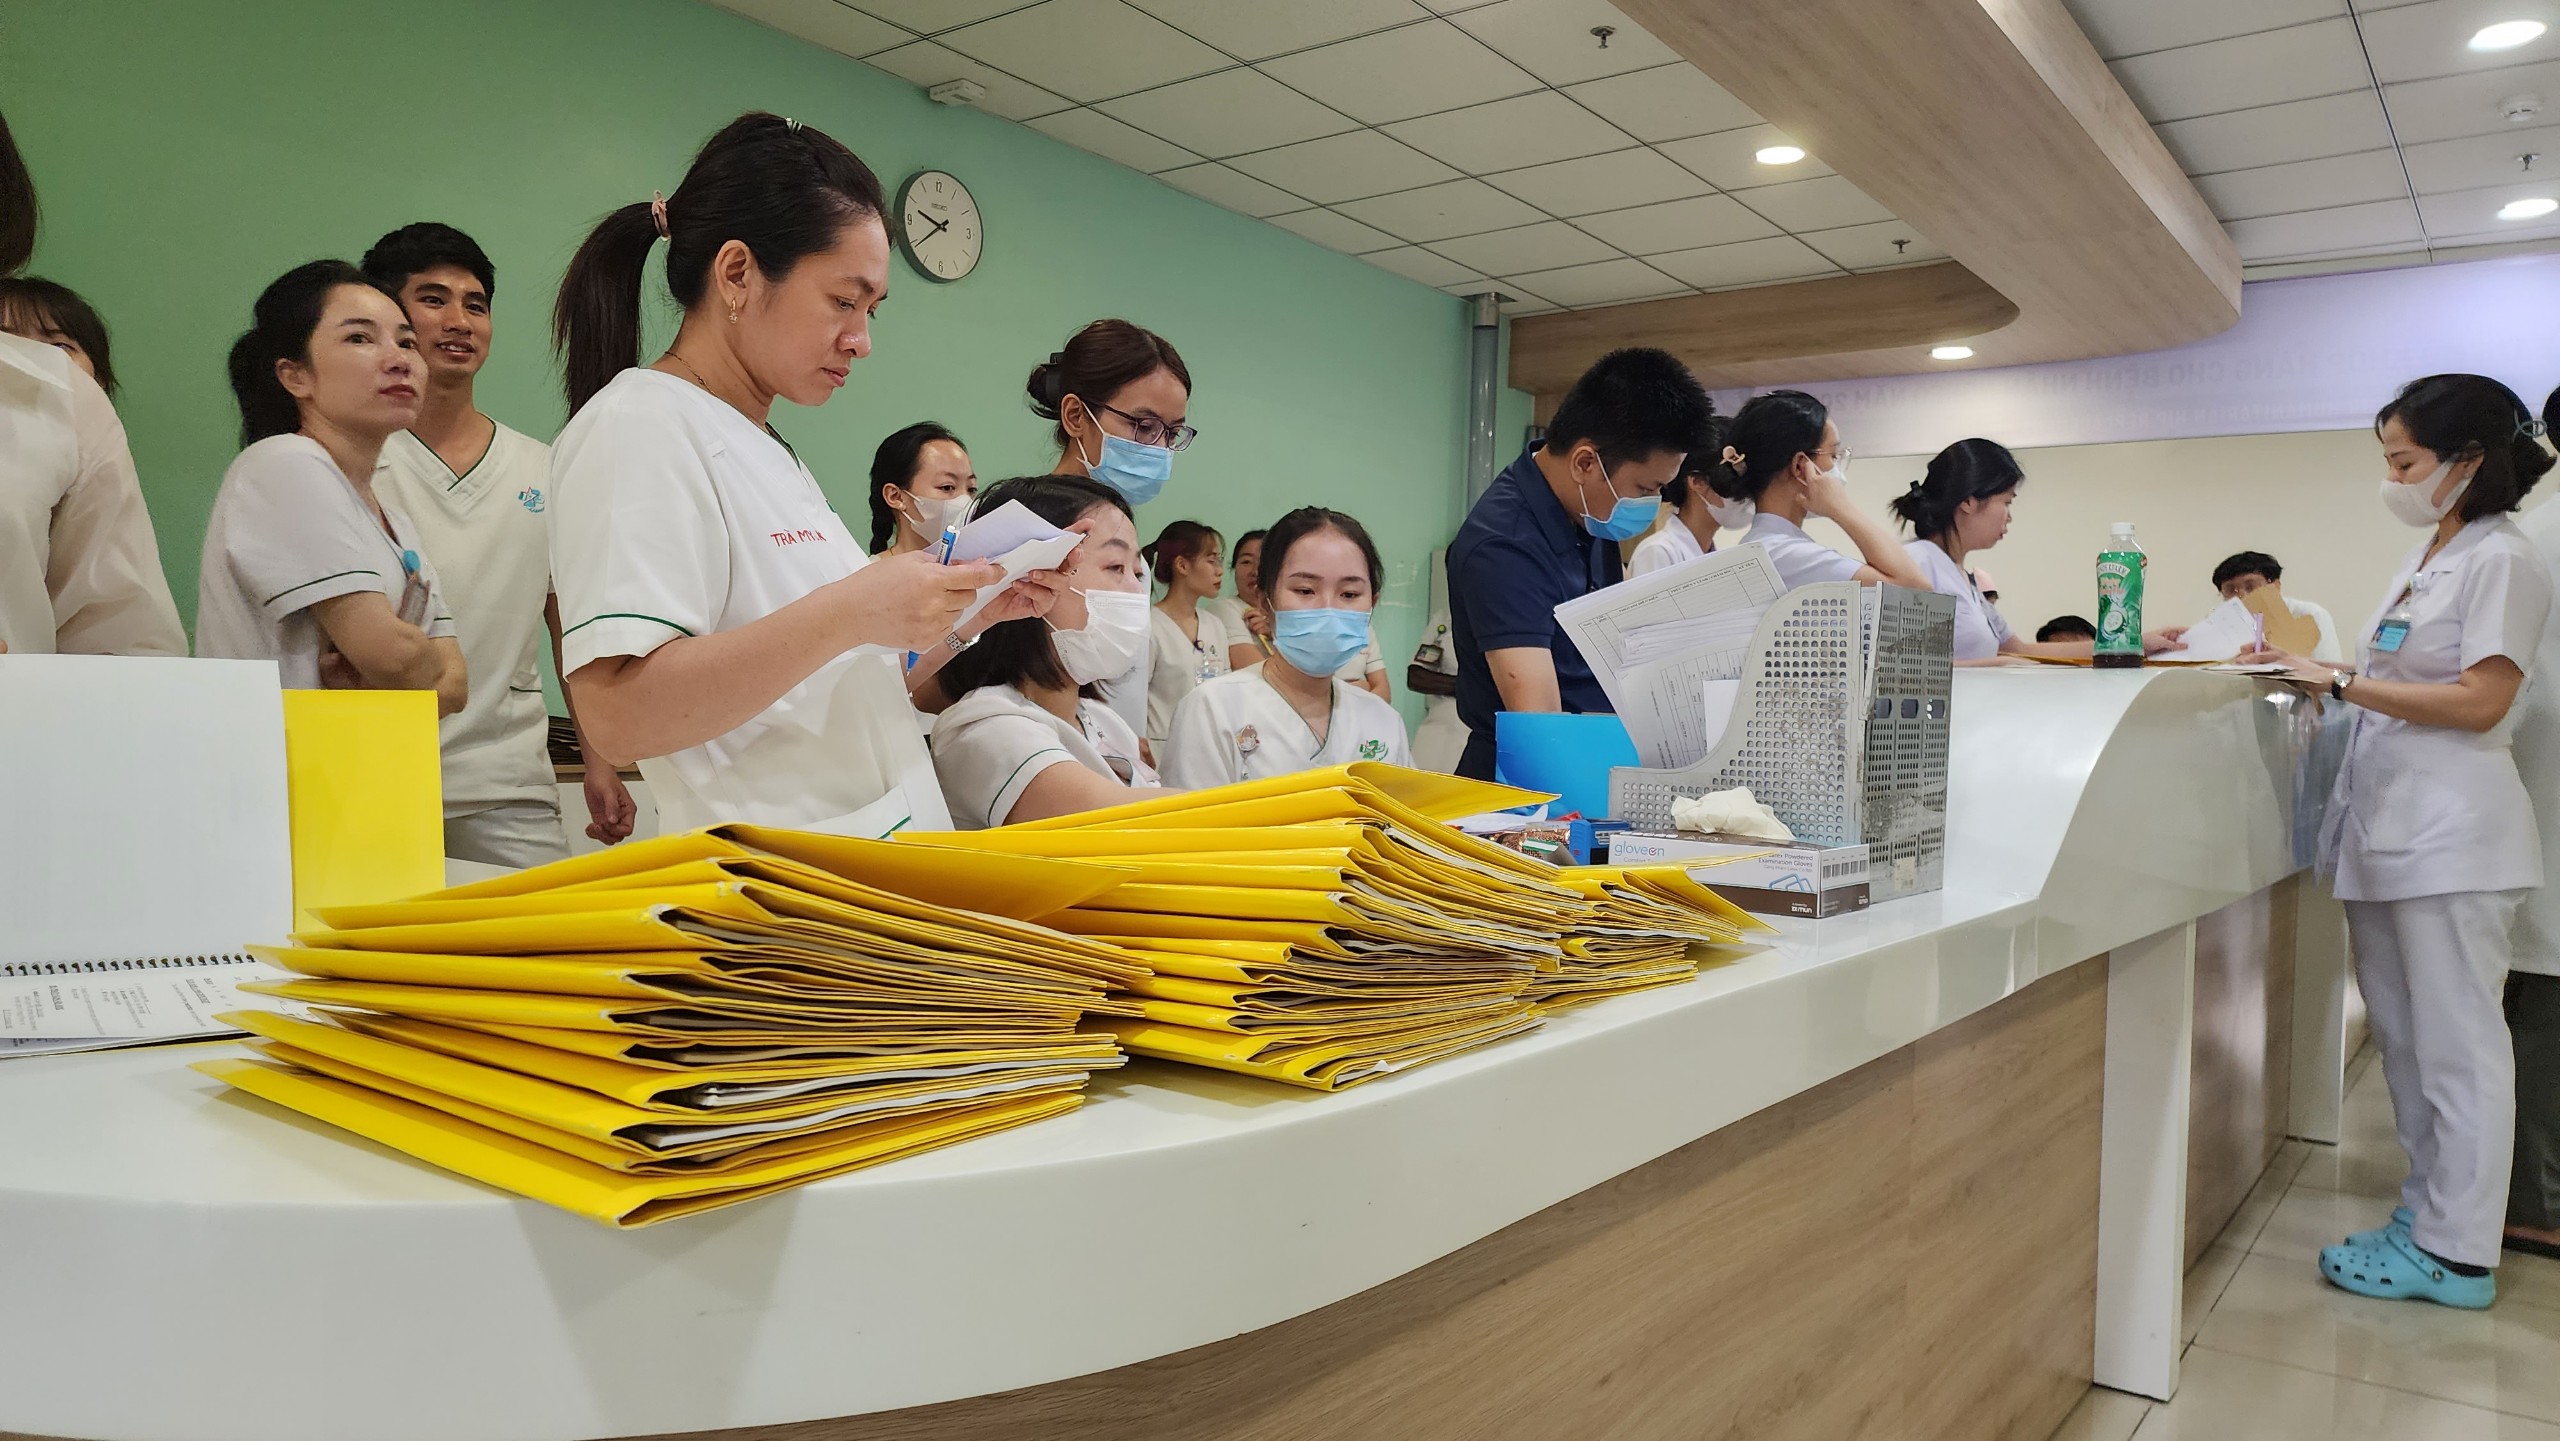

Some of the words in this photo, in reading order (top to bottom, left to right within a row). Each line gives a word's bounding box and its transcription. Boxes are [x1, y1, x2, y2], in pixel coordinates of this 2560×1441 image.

[935, 181, 943, 193] 12
[907, 213, 913, 226] 9
[966, 228, 972, 240] 3
[938, 260, 944, 273] 6
[770, 529, 797, 547] TRÀ
[1758, 857, 1793, 866] Examination
[1794, 860, 1813, 868] Gloves
[1784, 853, 1814, 861] Powdered
